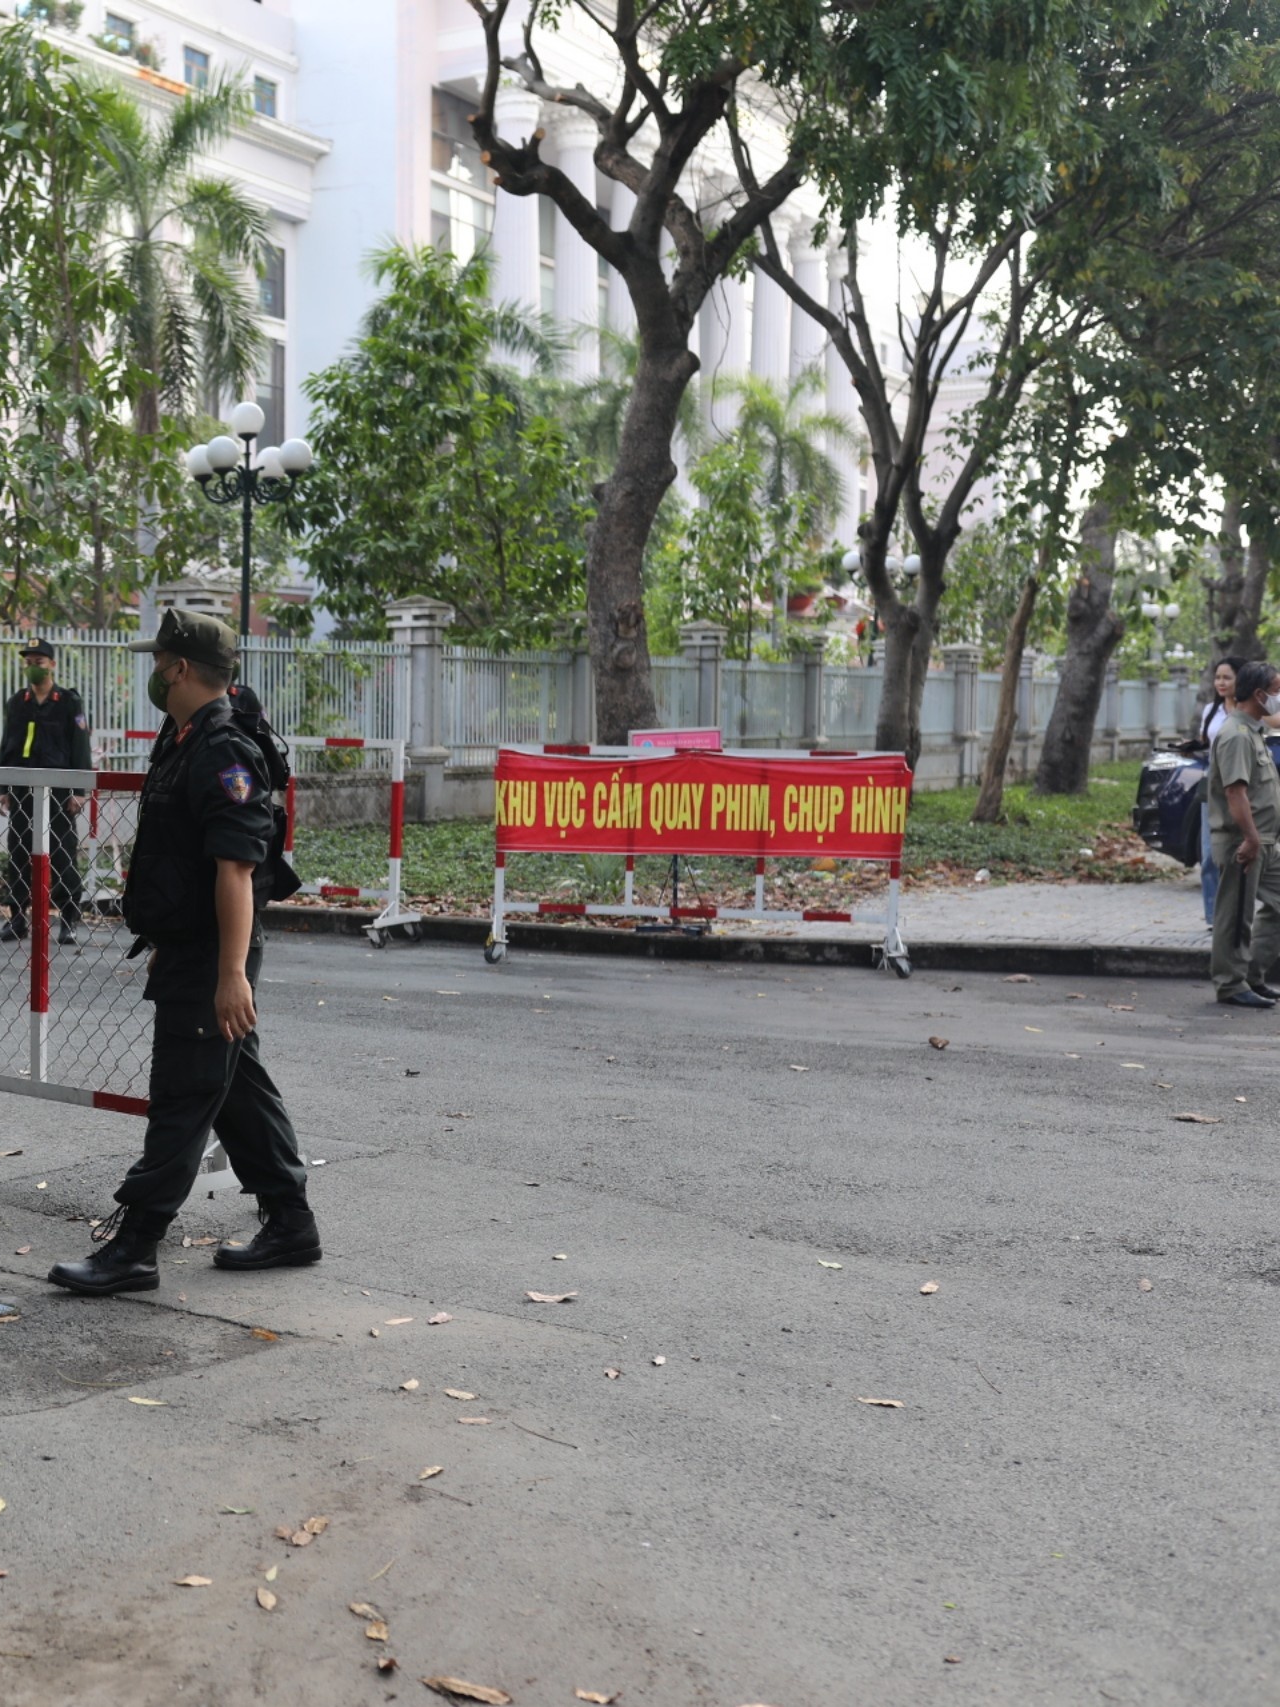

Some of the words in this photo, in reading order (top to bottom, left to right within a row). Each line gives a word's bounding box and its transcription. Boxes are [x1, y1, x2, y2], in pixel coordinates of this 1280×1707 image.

[495, 780, 537, 828] KHU
[543, 776, 586, 838] VỰC
[592, 767, 643, 830] CẤM
[649, 782, 705, 835] QUAY
[710, 783, 776, 838] PHIM,
[783, 784, 845, 843] CHỤP
[850, 776, 907, 834] HÌNH
